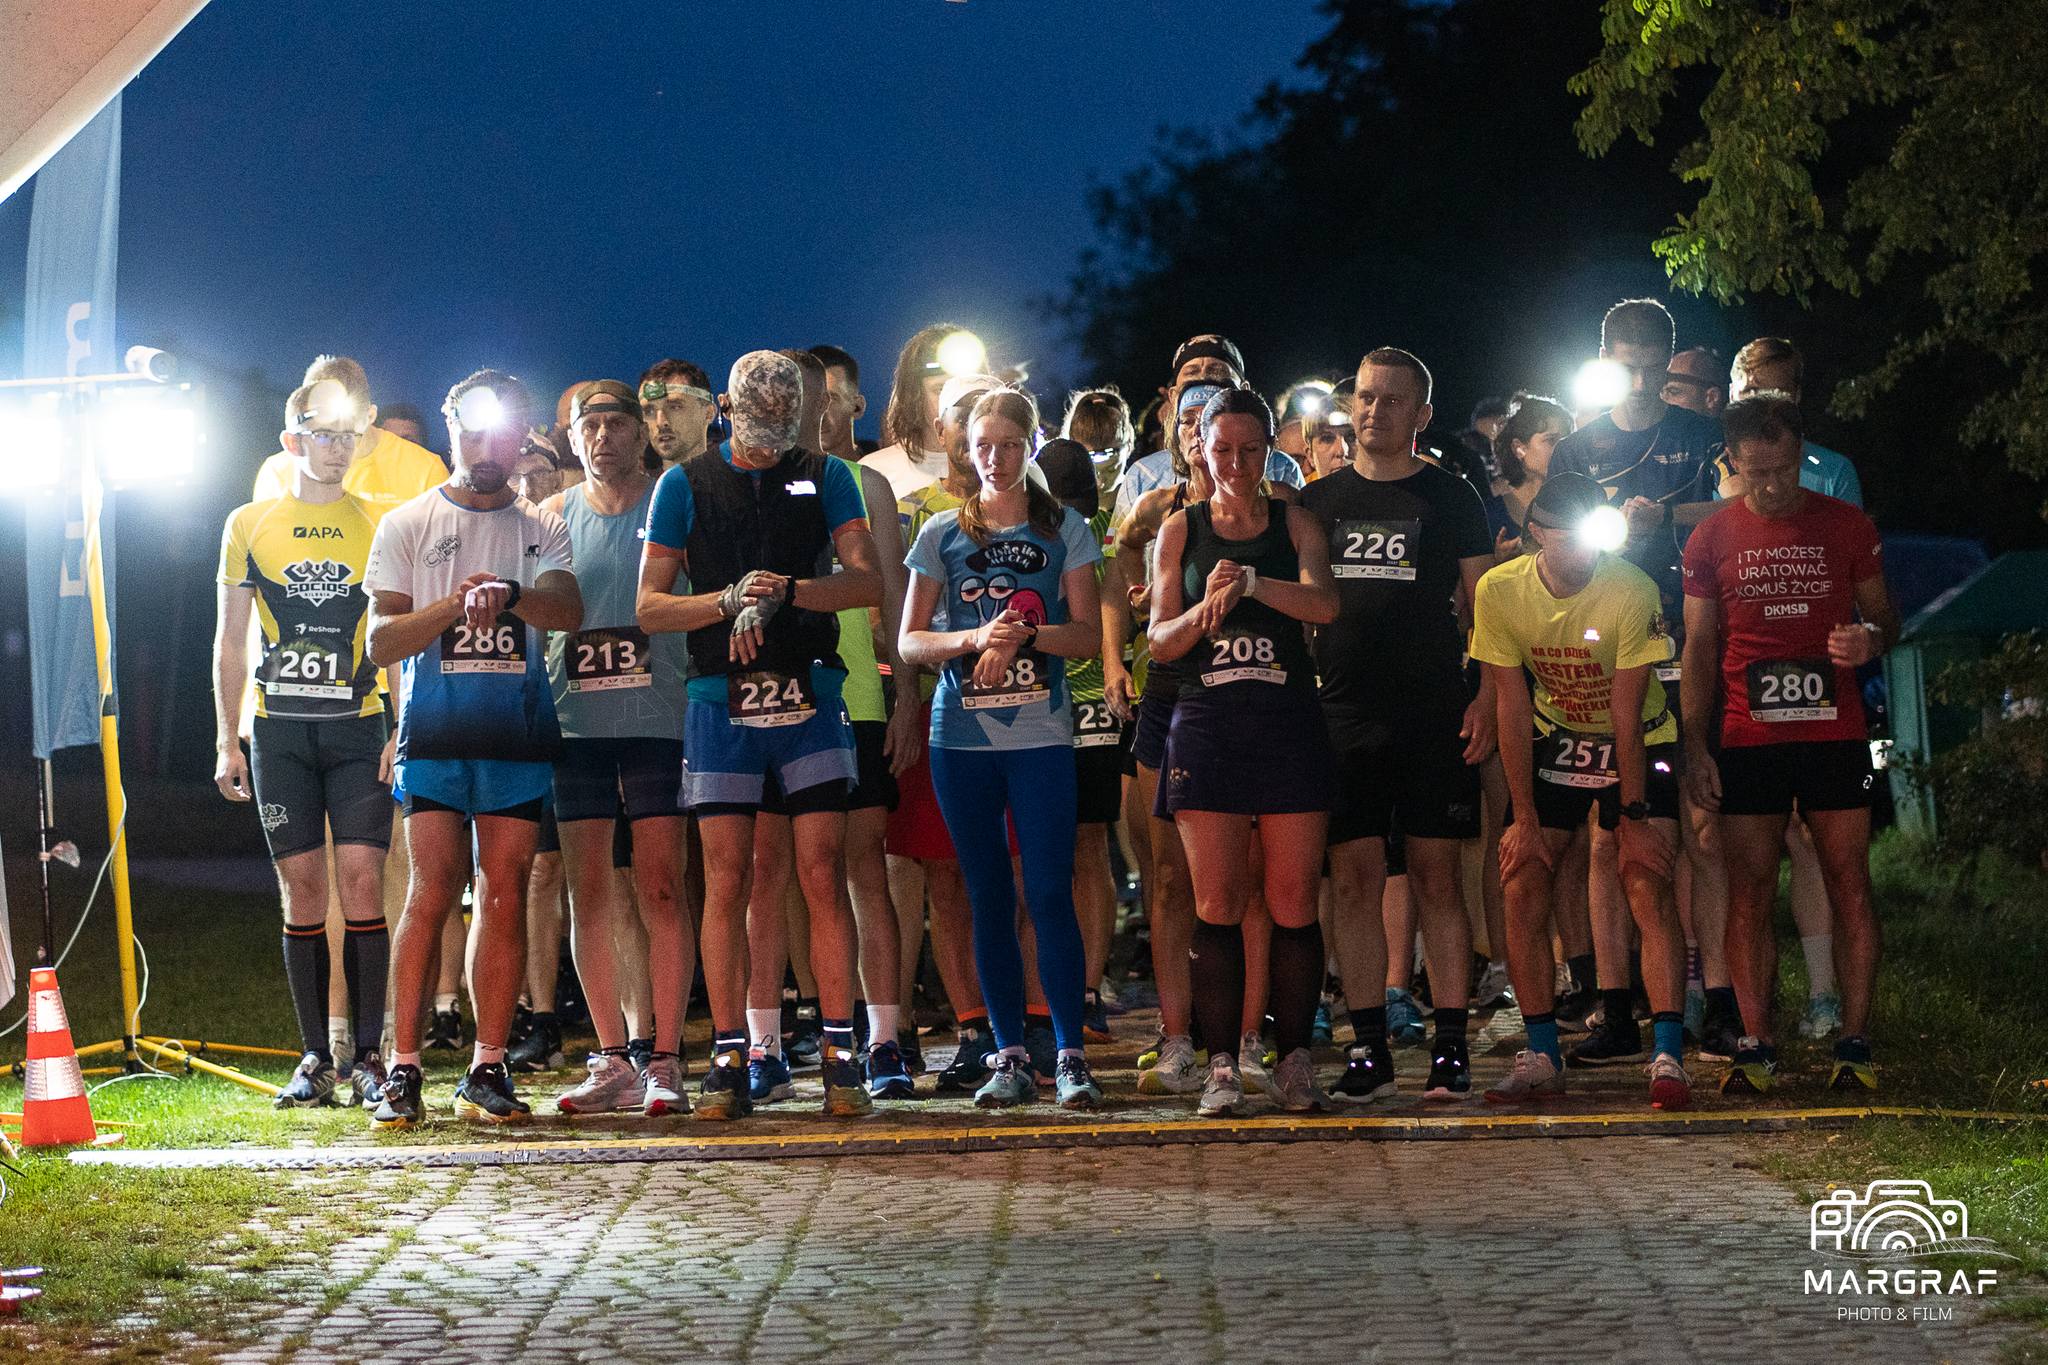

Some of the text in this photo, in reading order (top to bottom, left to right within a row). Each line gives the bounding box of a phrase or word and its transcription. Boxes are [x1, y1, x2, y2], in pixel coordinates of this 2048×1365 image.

[308, 527, 344, 539] APA
[1343, 532, 1406, 561] 226
[1737, 545, 1825, 565] I TY MOŻESZ
[1738, 560, 1829, 581] URATOWAĆ
[288, 582, 349, 597] SOCIOS
[1735, 577, 1788, 598] KOMUŚ
[1764, 604, 1798, 617] DKMS
[308, 625, 341, 634] ReShape
[453, 625, 515, 654] 286
[577, 640, 637, 672] 213
[1212, 637, 1275, 666] 208
[1547, 647, 1562, 658] CO
[1564, 646, 1592, 659] DZIEŃ
[280, 650, 338, 681] 261
[1533, 660, 1604, 681] JESTEM
[740, 678, 804, 710] 224
[1761, 673, 1824, 703] 280
[1078, 703, 1123, 730] 23
[1555, 738, 1612, 770] 251
